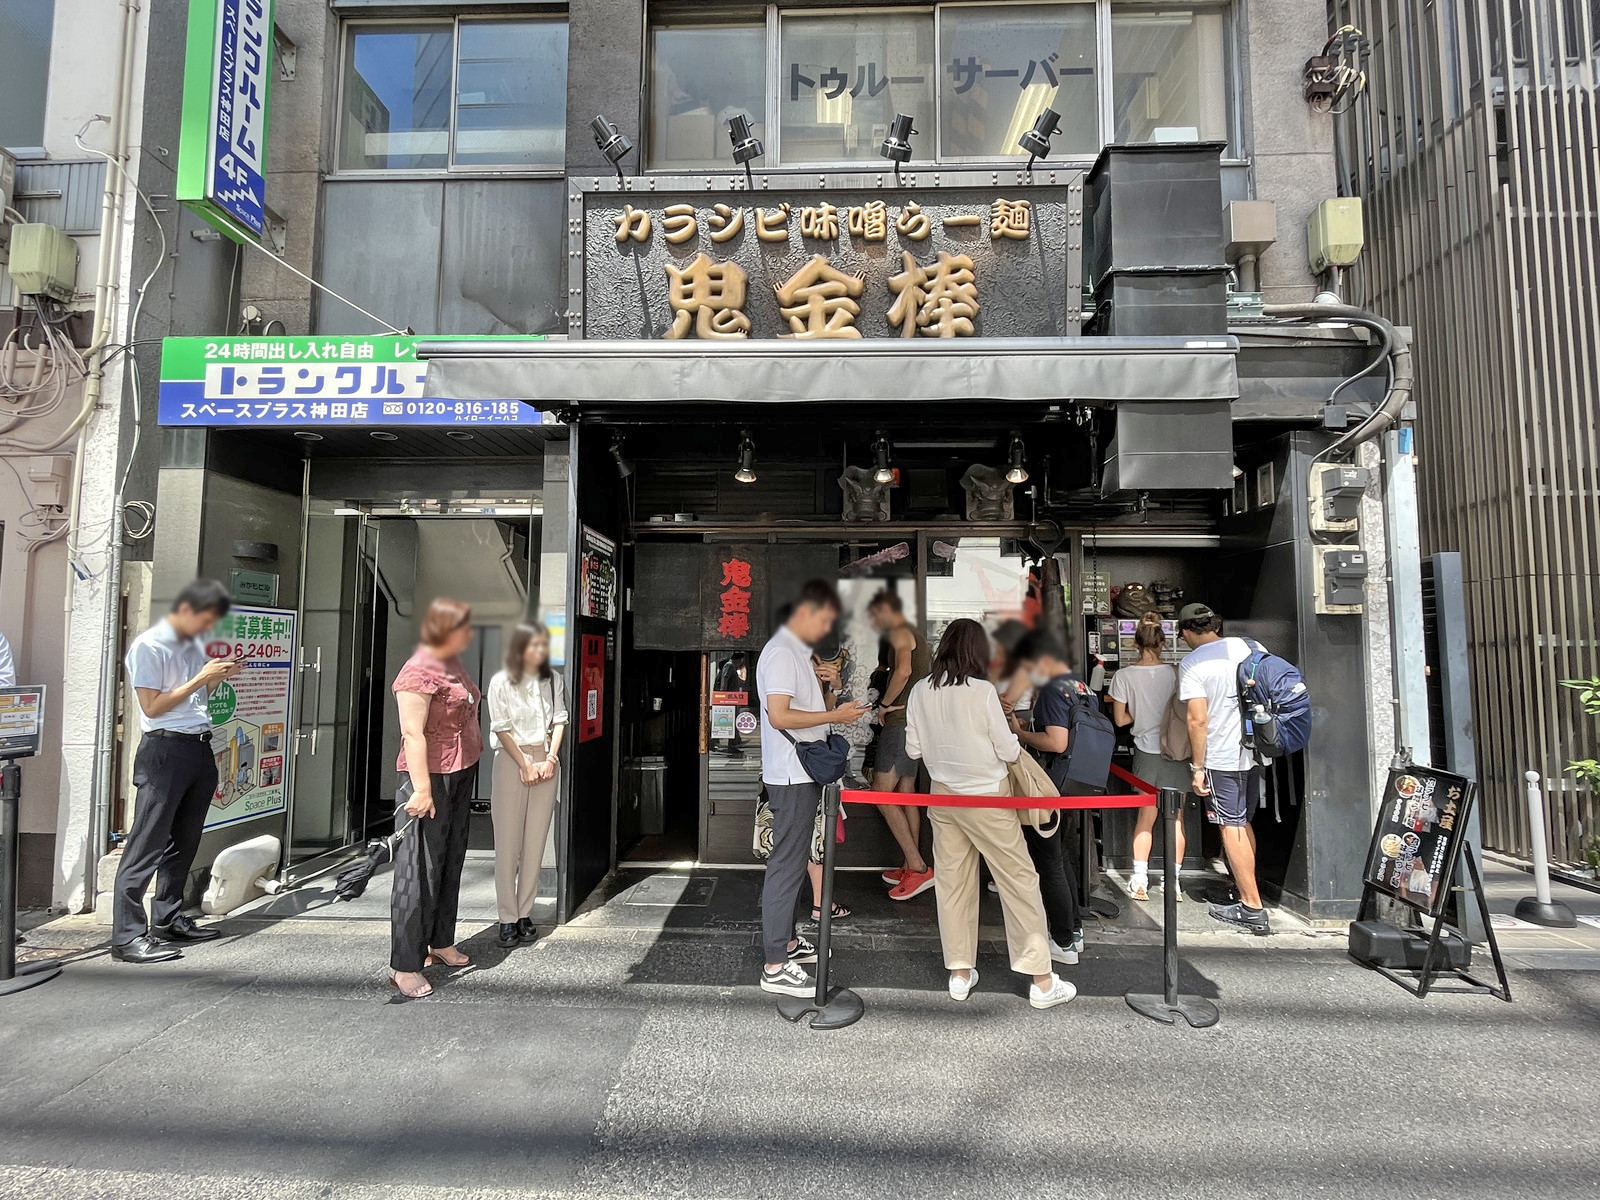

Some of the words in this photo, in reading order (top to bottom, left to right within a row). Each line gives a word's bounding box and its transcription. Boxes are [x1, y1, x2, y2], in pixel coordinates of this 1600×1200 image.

[791, 63, 924, 101] トゥルー
[947, 52, 1094, 94] サーバー
[219, 153, 248, 187] 4F
[615, 198, 1031, 243] カラシビ味噌らー麺
[663, 251, 981, 339] 鬼金棒
[204, 342, 374, 359] 24時間出し入れ自由
[180, 401, 369, 419] スペースプラス神田店
[406, 402, 520, 415] 0120-816-185
[454, 414, 518, 422] ハイローイーハコ
[717, 558, 752, 639] 鬼金棒
[245, 800, 265, 811] Space
[266, 796, 282, 806] Plus
[1438, 785, 1462, 831] お土産
